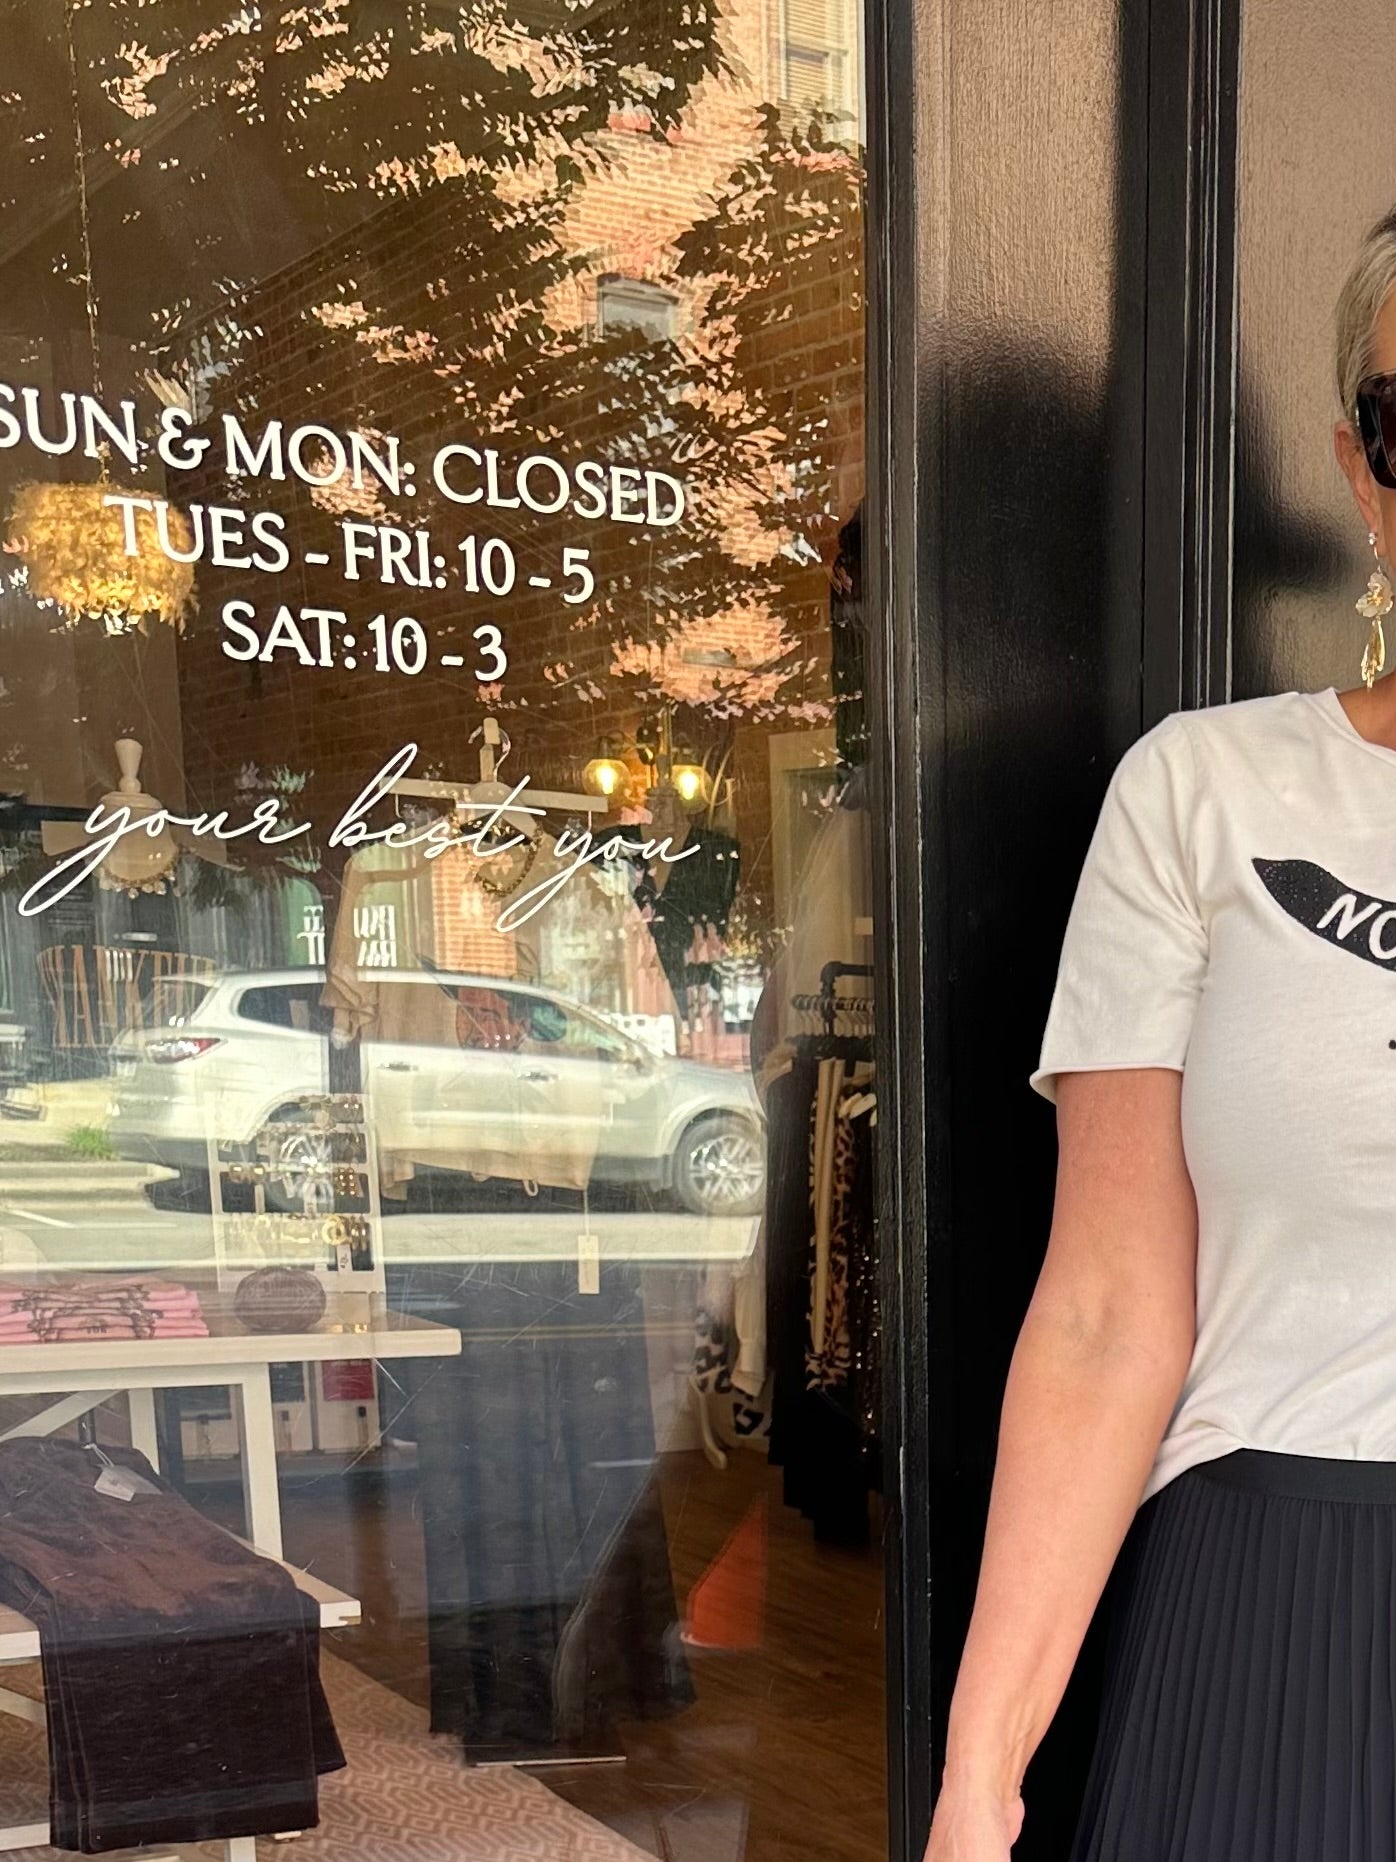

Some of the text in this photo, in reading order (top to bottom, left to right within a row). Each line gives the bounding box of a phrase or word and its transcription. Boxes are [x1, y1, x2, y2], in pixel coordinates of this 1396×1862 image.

[158, 406, 211, 470] &
[222, 413, 416, 497] MON:
[433, 443, 685, 527] CLOSED
[103, 494, 595, 604] TUES - FRI: 10 - 5
[222, 600, 508, 681] SAT: 10 - 3
[18, 743, 701, 933] your best you
